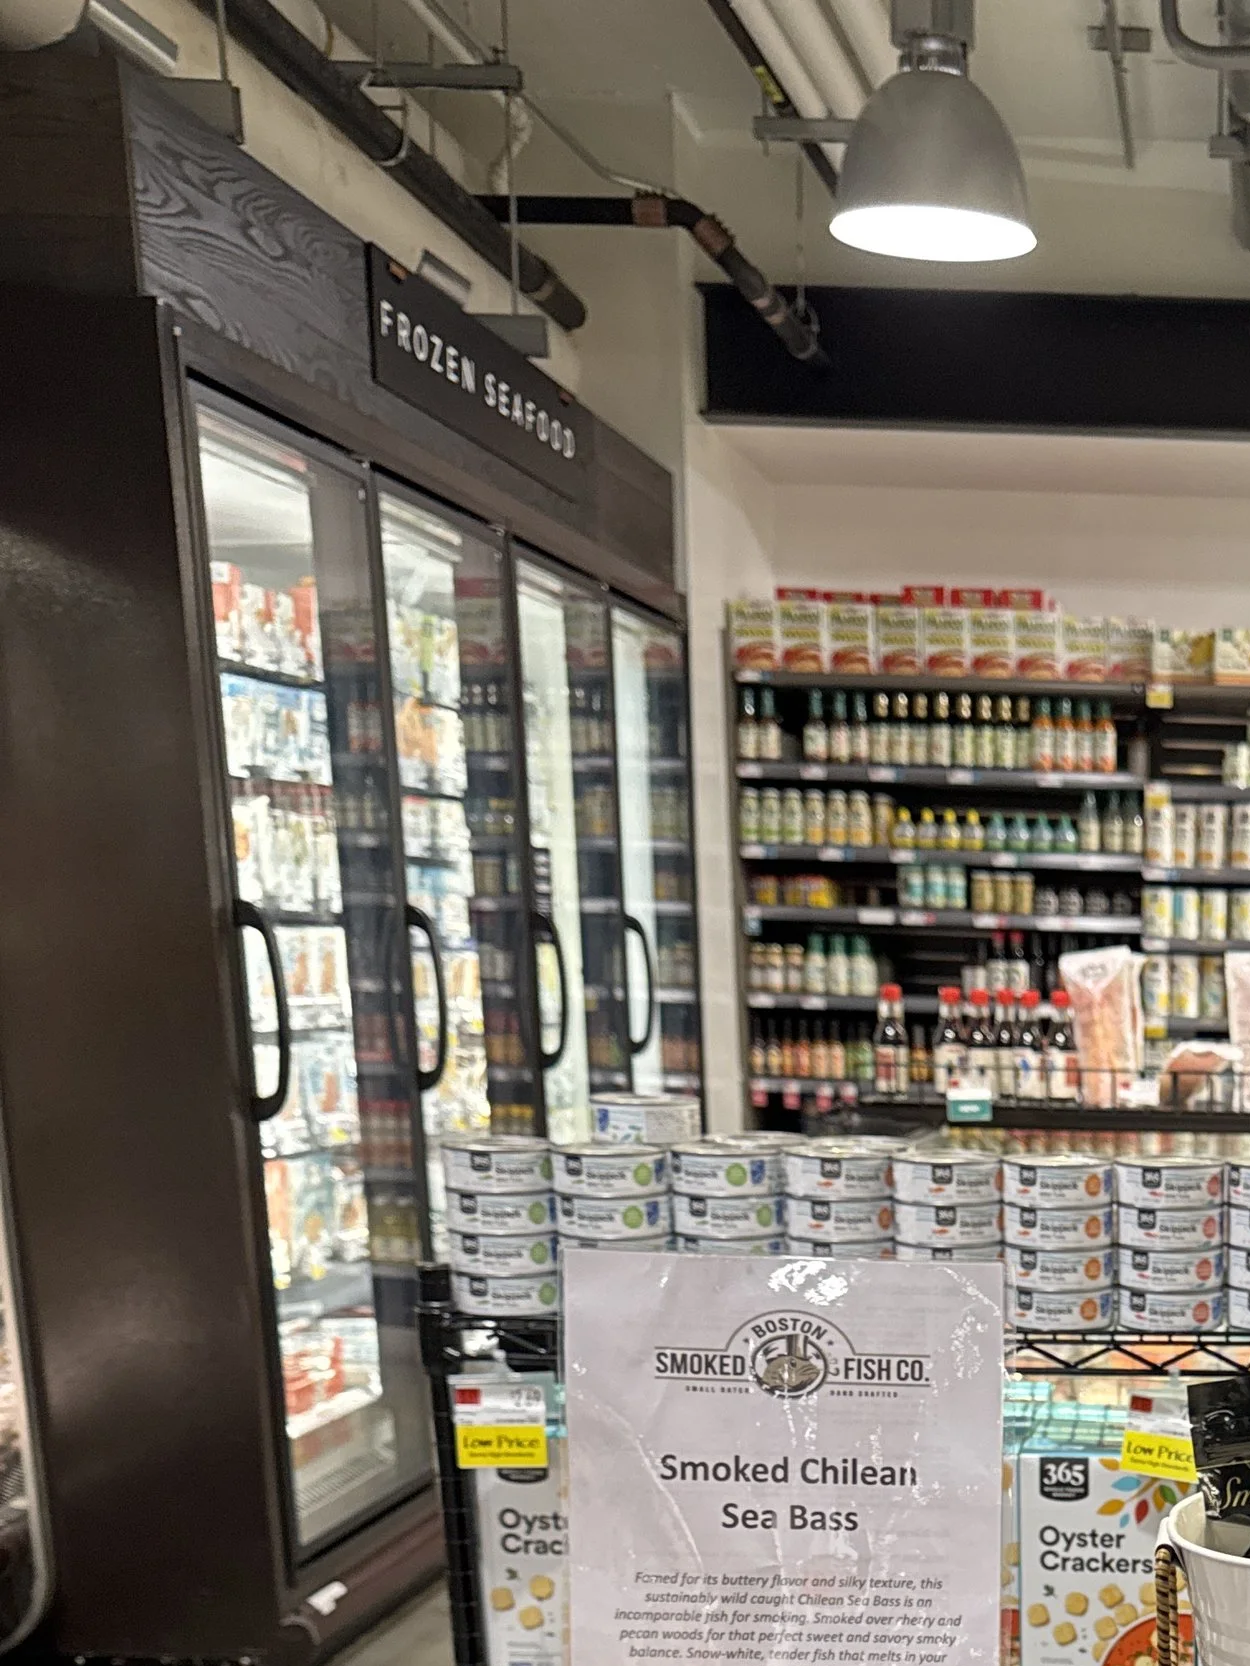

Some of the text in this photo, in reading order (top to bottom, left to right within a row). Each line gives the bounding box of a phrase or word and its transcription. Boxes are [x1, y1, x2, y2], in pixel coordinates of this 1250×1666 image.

[378, 300, 576, 460] FROZEN SEAFOOD
[750, 1317, 828, 1341] BOSTON
[655, 1351, 931, 1383] SMOKED FISH CO.
[721, 1386, 751, 1394] BATC
[1126, 1440, 1154, 1456] Low
[659, 1454, 918, 1487] Smoked Chilean
[1042, 1462, 1085, 1486] 365
[499, 1507, 569, 1535] Oyst
[721, 1502, 859, 1532] Sea Bass
[500, 1533, 569, 1556] Crac
[1039, 1525, 1125, 1553] Oyster
[1040, 1550, 1154, 1574] Crackers
[680, 1572, 700, 1587] for
[703, 1574, 718, 1585] its
[722, 1574, 769, 1588] buttery
[771, 1575, 808, 1589] flavor
[812, 1576, 836, 1587] and
[839, 1576, 867, 1590] silky
[869, 1577, 917, 1591] texture,
[920, 1578, 943, 1590] this
[645, 1592, 932, 1608] sustainably wild caught Chilean Sea Bass is an
[614, 1608, 702, 1624] incomparable
[730, 1611, 750, 1625] for
[813, 1612, 863, 1625] Smoked
[865, 1614, 893, 1625] over
[937, 1614, 962, 1627] and
[619, 1629, 659, 1641] pecan
[662, 1628, 704, 1640] woods
[704, 1628, 725, 1643] for
[728, 1629, 755, 1641] that
[806, 1632, 843, 1643] sweet
[846, 1632, 871, 1643] and
[873, 1634, 913, 1646] savory
[916, 1633, 957, 1647] smoky
[629, 1646, 948, 1665] balance. Snow-white, tender fish that melts in your
